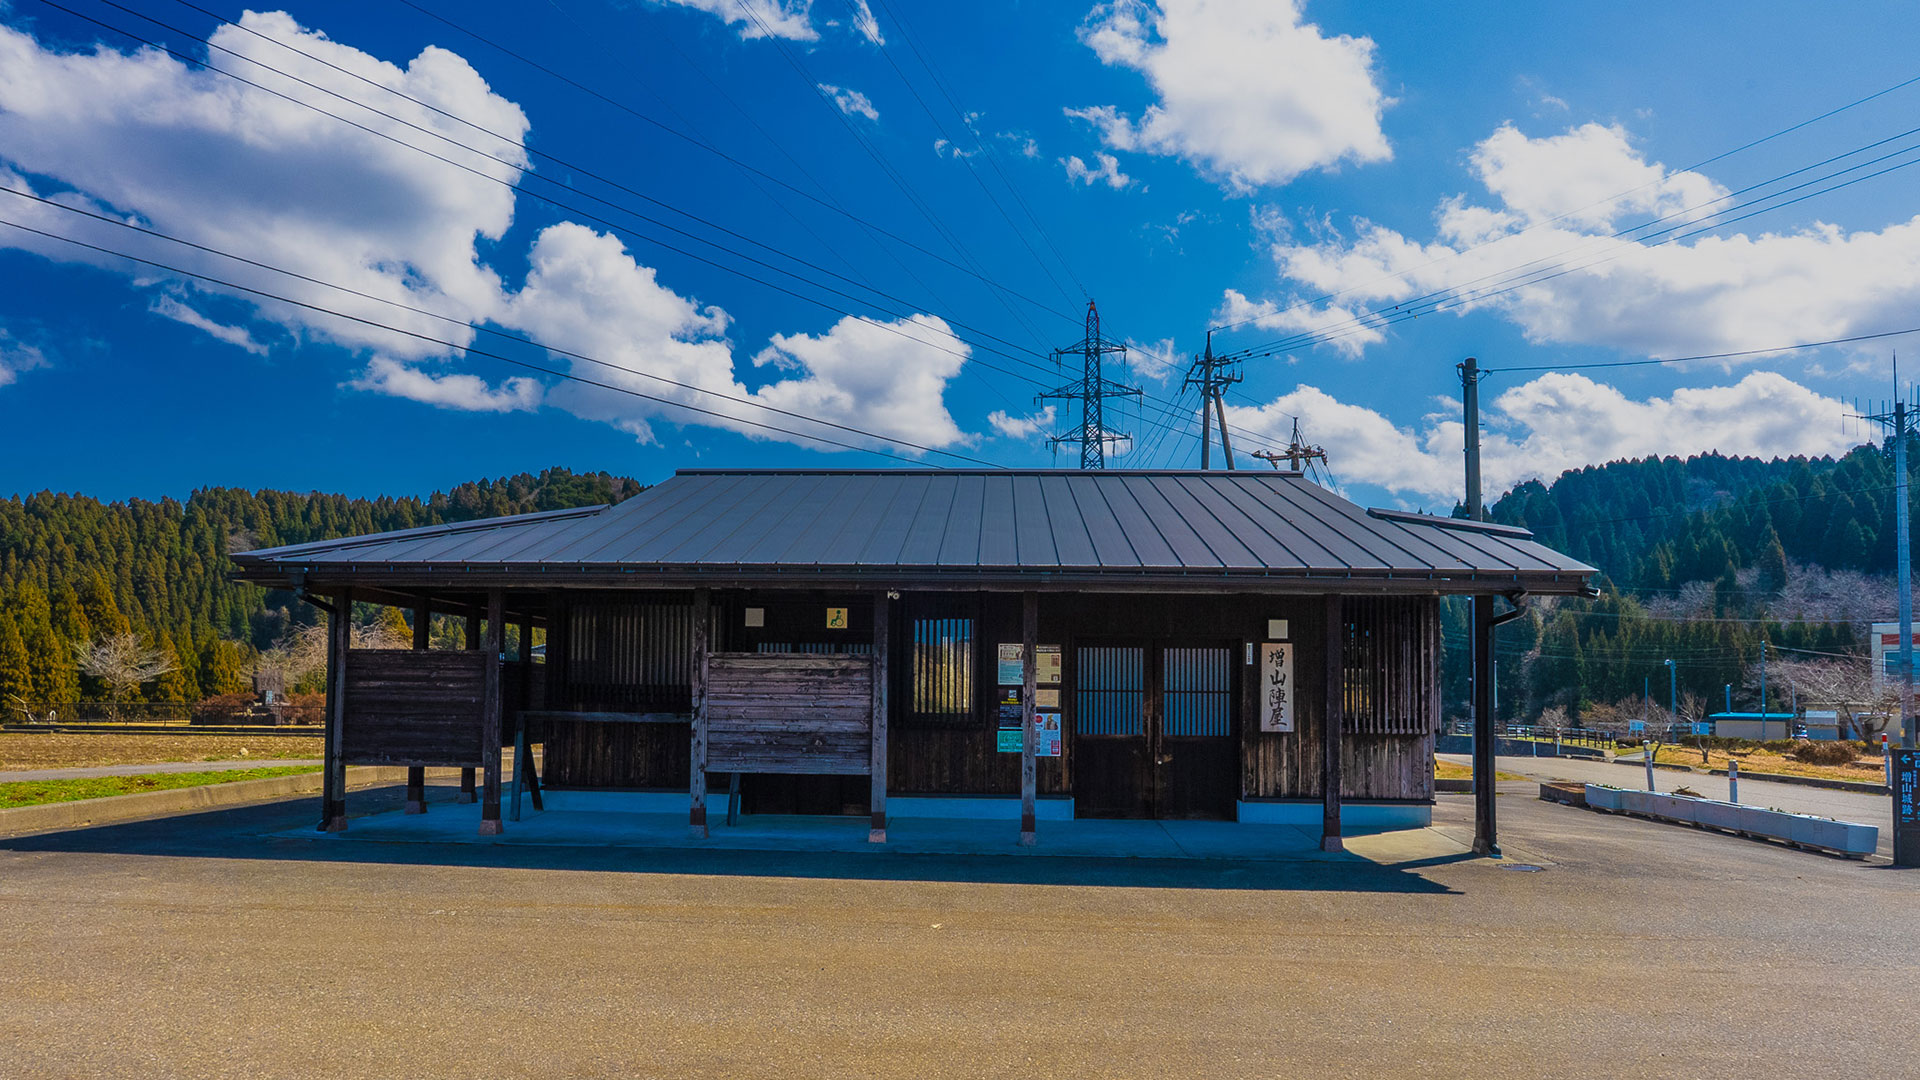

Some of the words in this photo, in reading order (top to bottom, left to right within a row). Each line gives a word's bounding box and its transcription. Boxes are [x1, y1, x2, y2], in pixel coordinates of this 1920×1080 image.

[1269, 648, 1287, 726] 増山陣屋
[1901, 771, 1913, 815] 増山城跡
